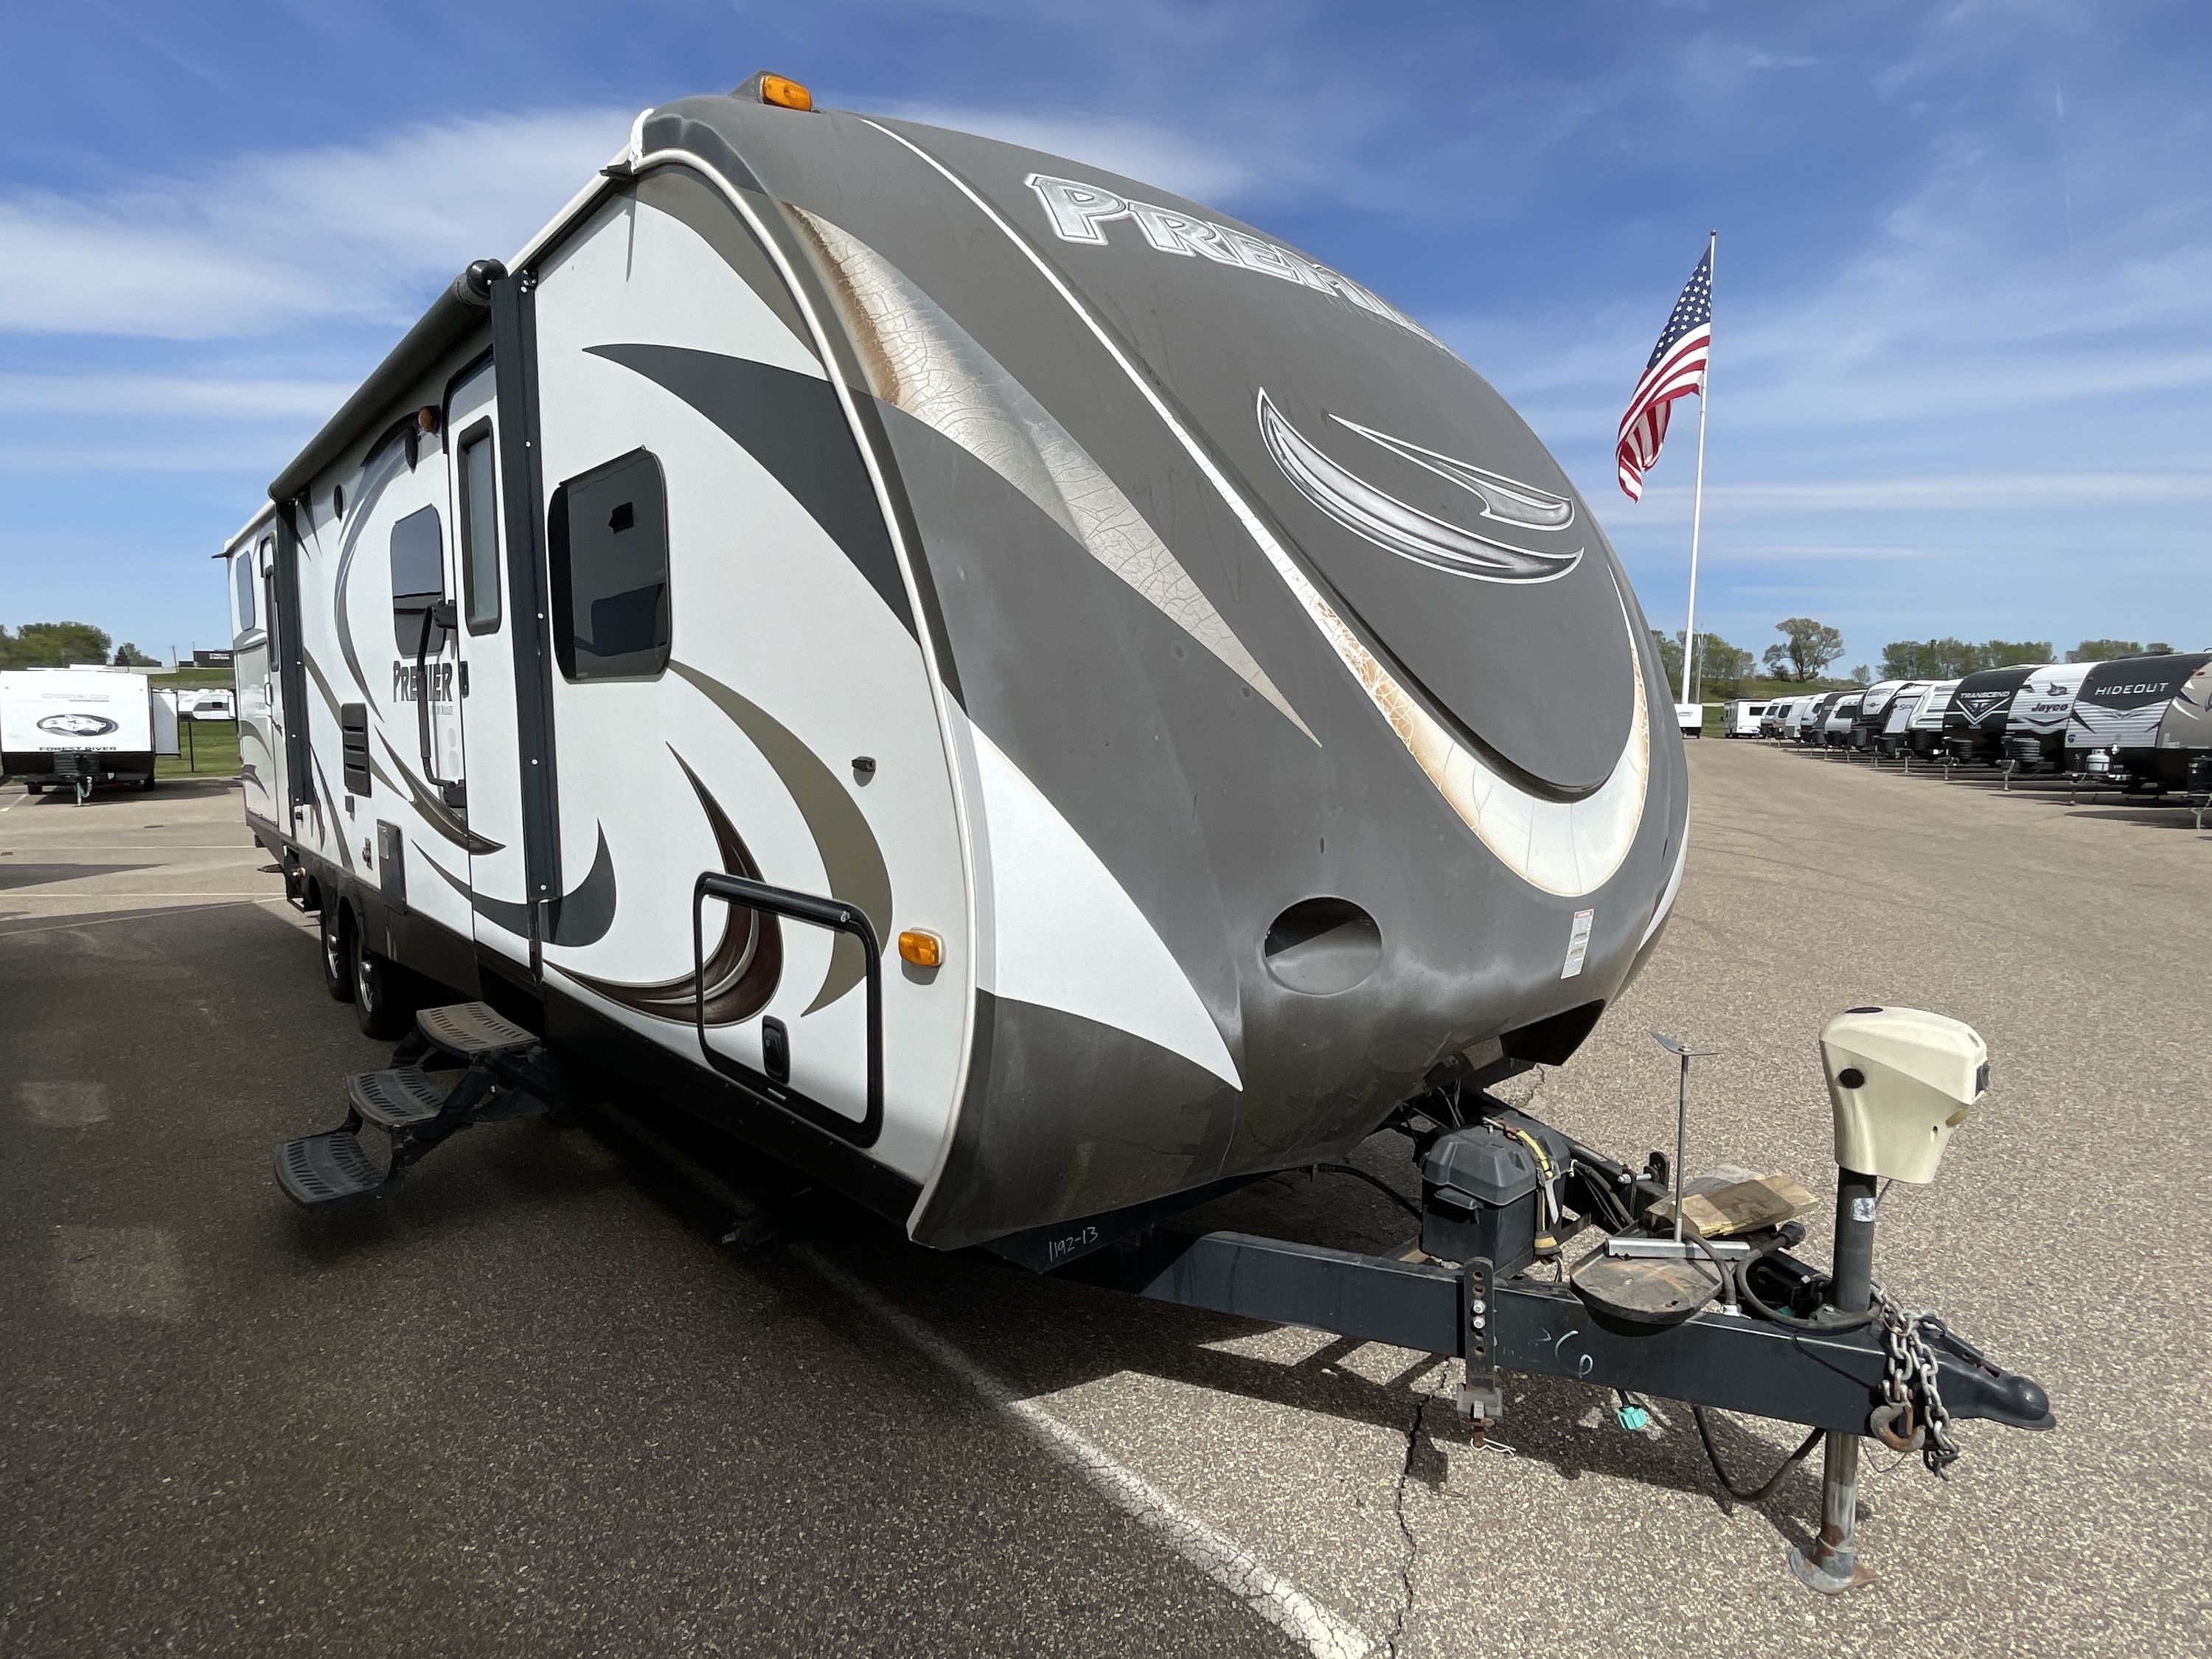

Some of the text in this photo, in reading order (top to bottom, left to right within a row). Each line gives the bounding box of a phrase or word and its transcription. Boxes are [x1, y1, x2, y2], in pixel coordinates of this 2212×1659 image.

[2094, 682, 2169, 695] HIDEOUT
[1960, 691, 2011, 699] TRANSCEND
[2031, 703, 2068, 712] Jayco
[1048, 1226, 1099, 1263] 1192-13
